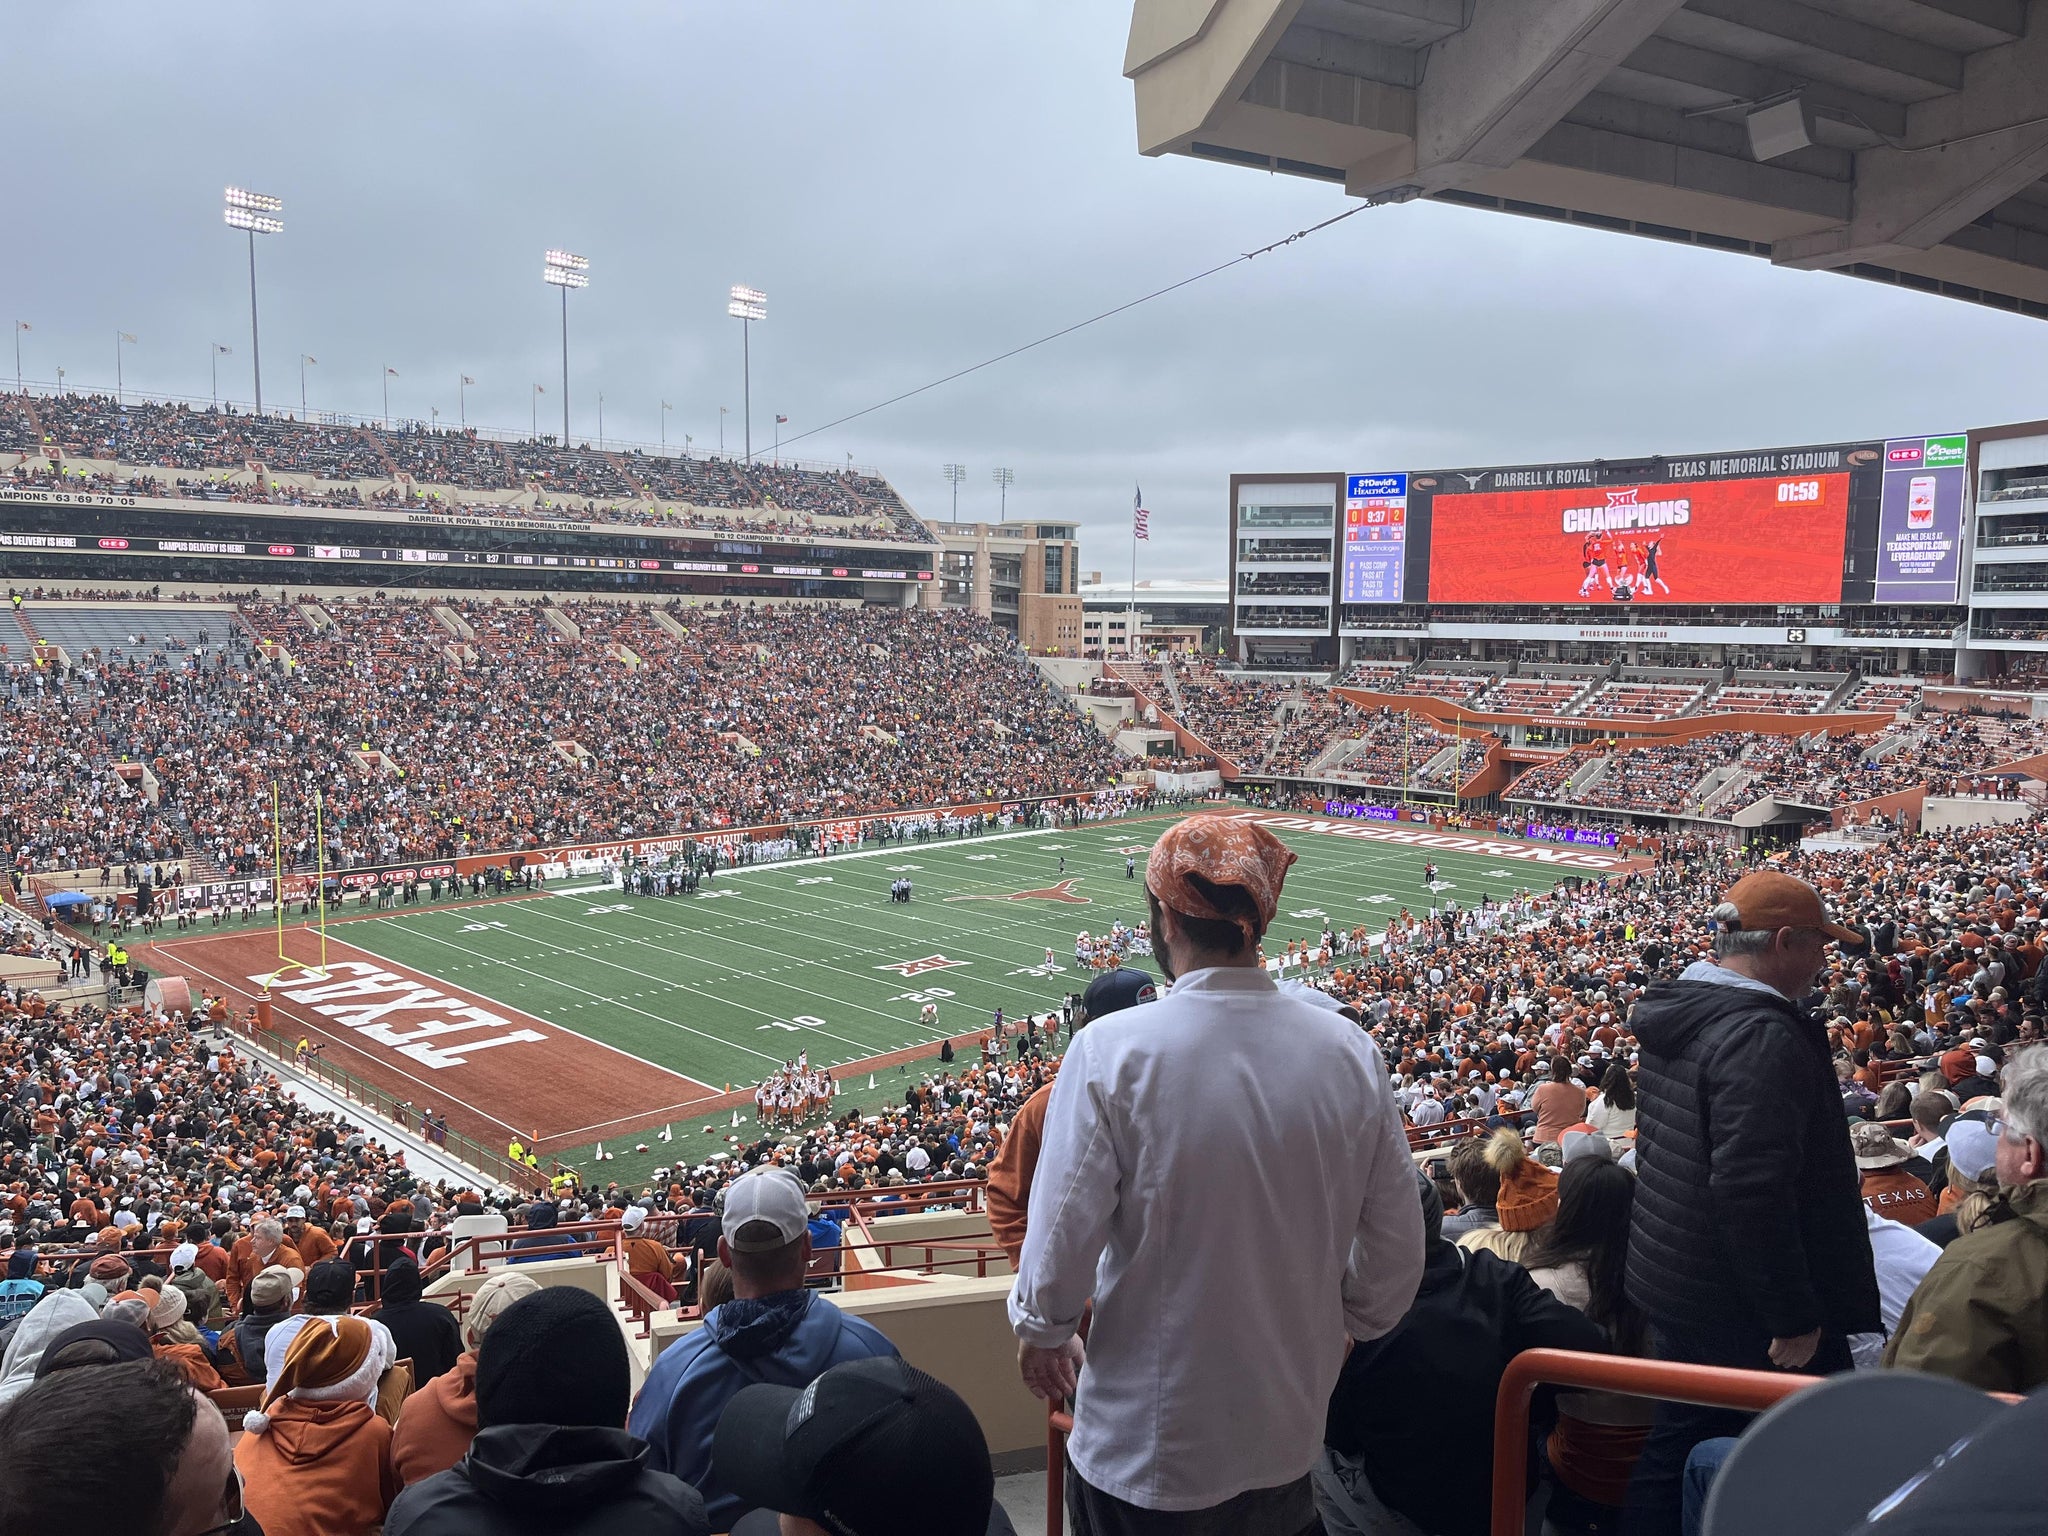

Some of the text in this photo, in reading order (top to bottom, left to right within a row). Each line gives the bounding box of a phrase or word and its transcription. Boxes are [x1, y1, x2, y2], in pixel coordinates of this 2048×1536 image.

[1668, 452, 1840, 478] TEXAS MEMORIAL STADIUM
[1494, 468, 1592, 488] DARRELL K ROYAL
[1777, 481, 1819, 502] 01:58
[52, 494, 70, 502] '63
[75, 495, 92, 504] '69
[96, 496, 114, 504] '70
[118, 498, 136, 506] '05
[408, 515, 446, 524] DARRELL
[518, 522, 554, 530] MEMORIAL
[1352, 510, 1400, 523] 0 9:37 2
[1563, 500, 1690, 533] CHAMPIONS
[13, 536, 46, 546] DELIVERY
[47, 537, 55, 547] IS
[56, 537, 76, 547] HERE!
[158, 541, 246, 553] CAMPUS DELIVERY IS HERE!
[341, 549, 360, 558] TEXAS
[464, 554, 469, 562] 2
[486, 554, 499, 563] 9:37
[628, 560, 636, 568] 25
[1788, 630, 1803, 642] 25
[1692, 822, 1715, 832] BEVO
[640, 840, 684, 854] MEMORI
[1225, 813, 1630, 868] LONGHORNS
[422, 866, 452, 878] H-E-B
[212, 884, 227, 894] 9:37
[899, 987, 956, 1003] 20
[246, 962, 549, 1069] TEXAS
[768, 1015, 826, 1032] 10
[1862, 1188, 1925, 1206] TEXAS
